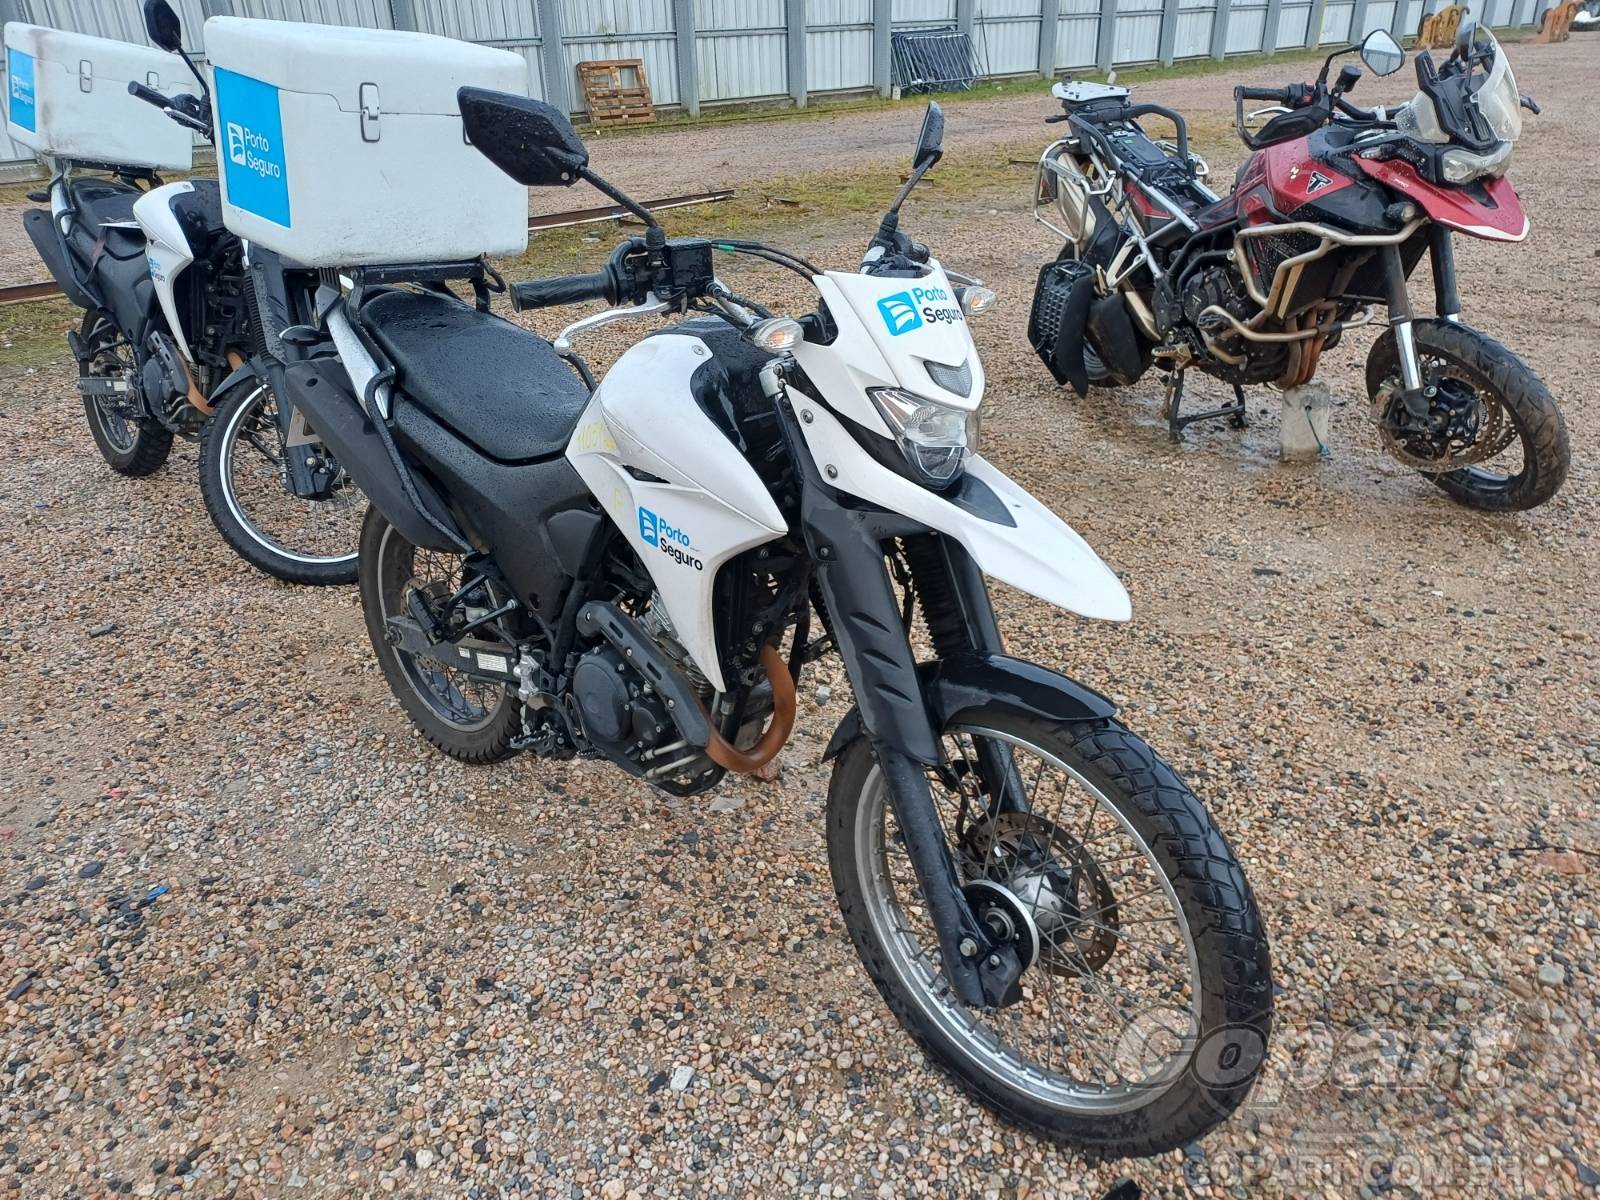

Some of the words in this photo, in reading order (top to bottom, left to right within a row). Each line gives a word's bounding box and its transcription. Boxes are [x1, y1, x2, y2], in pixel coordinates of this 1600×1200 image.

[244, 127, 269, 152] Porto
[246, 150, 280, 178] Seguro
[912, 286, 948, 304] Porto
[922, 306, 964, 325] Seguro
[659, 518, 690, 546] Porto
[660, 537, 703, 571] Seguro
